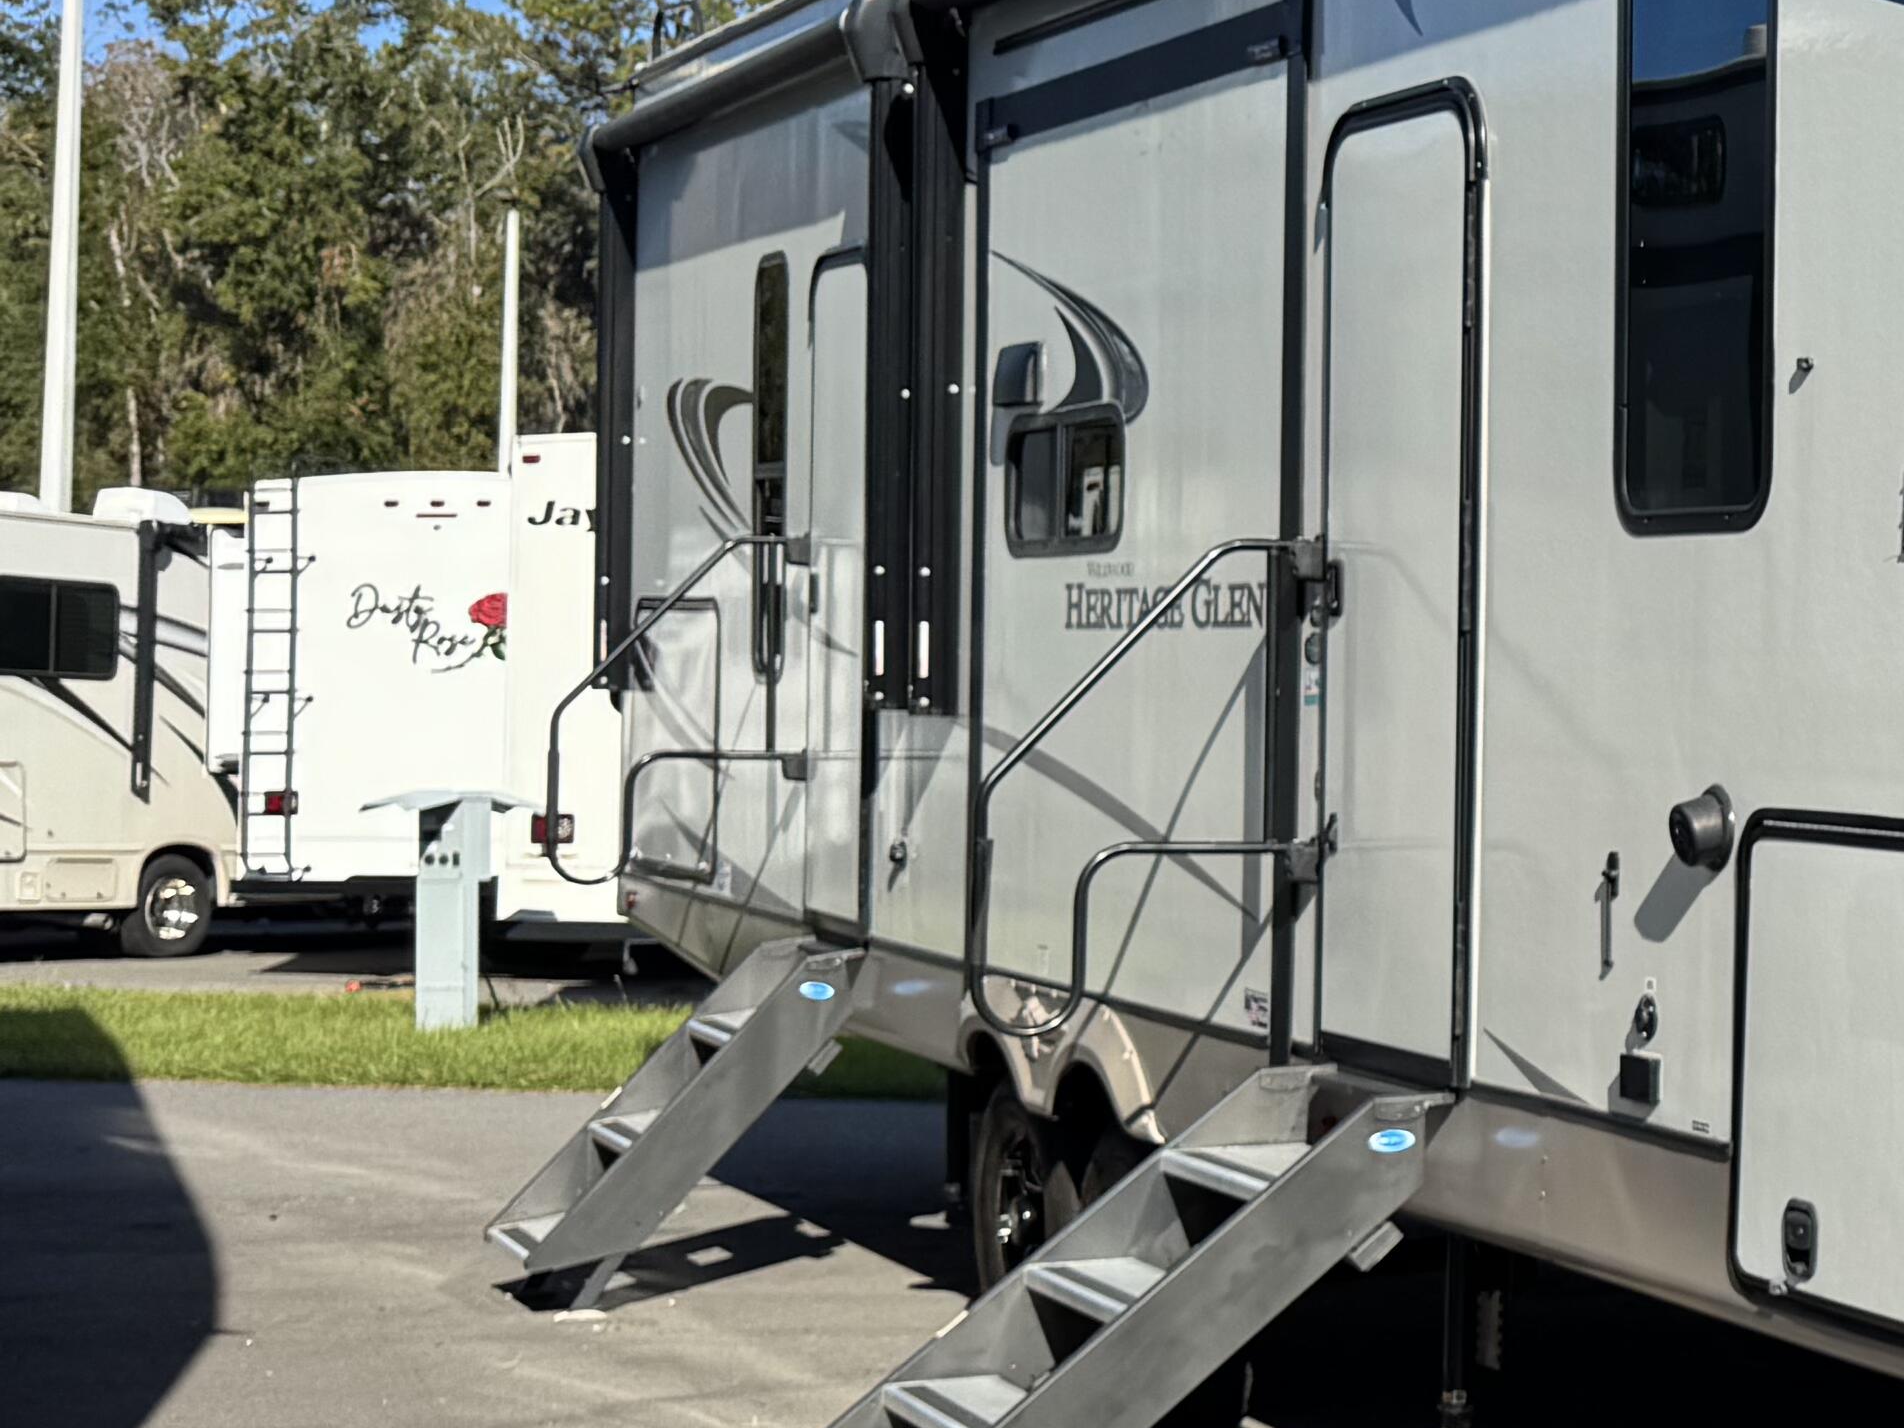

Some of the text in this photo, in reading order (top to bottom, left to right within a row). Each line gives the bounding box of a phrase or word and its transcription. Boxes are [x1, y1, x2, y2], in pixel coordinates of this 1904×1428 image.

[346, 583, 435, 634] Dusty
[1190, 575, 1267, 629] GLEN
[411, 618, 476, 664] Rose
